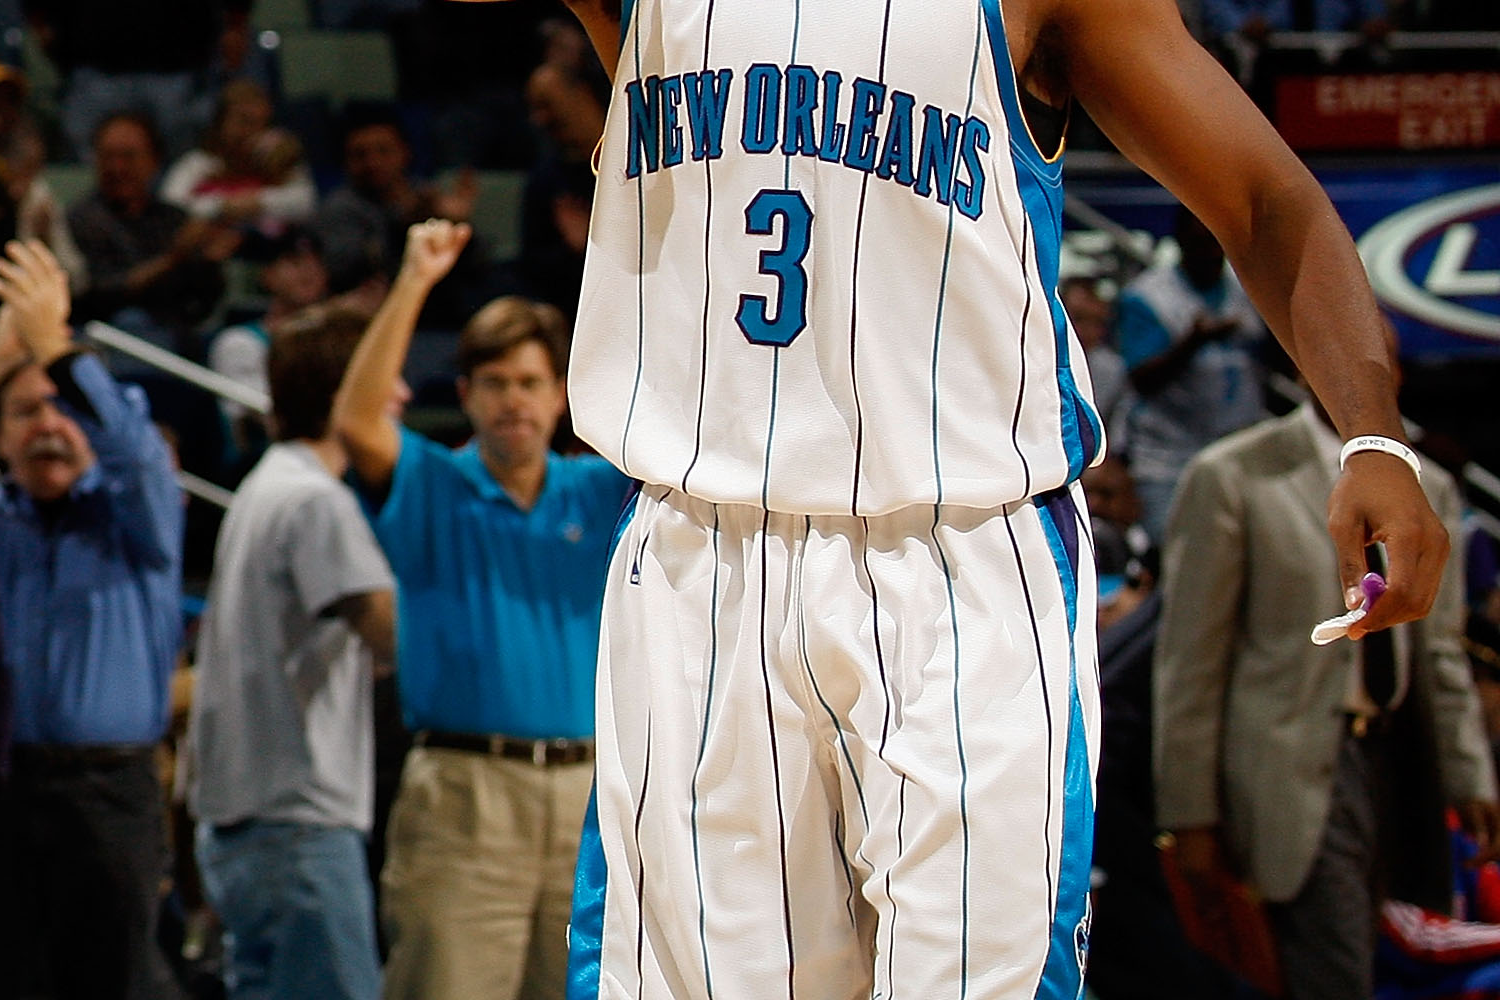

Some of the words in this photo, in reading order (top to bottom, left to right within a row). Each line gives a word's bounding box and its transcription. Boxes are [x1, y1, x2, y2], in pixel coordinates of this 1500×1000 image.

[625, 66, 732, 180] NEW
[741, 63, 991, 221] ORLEANS
[1398, 107, 1488, 150] EXIT
[735, 189, 814, 347] 3
